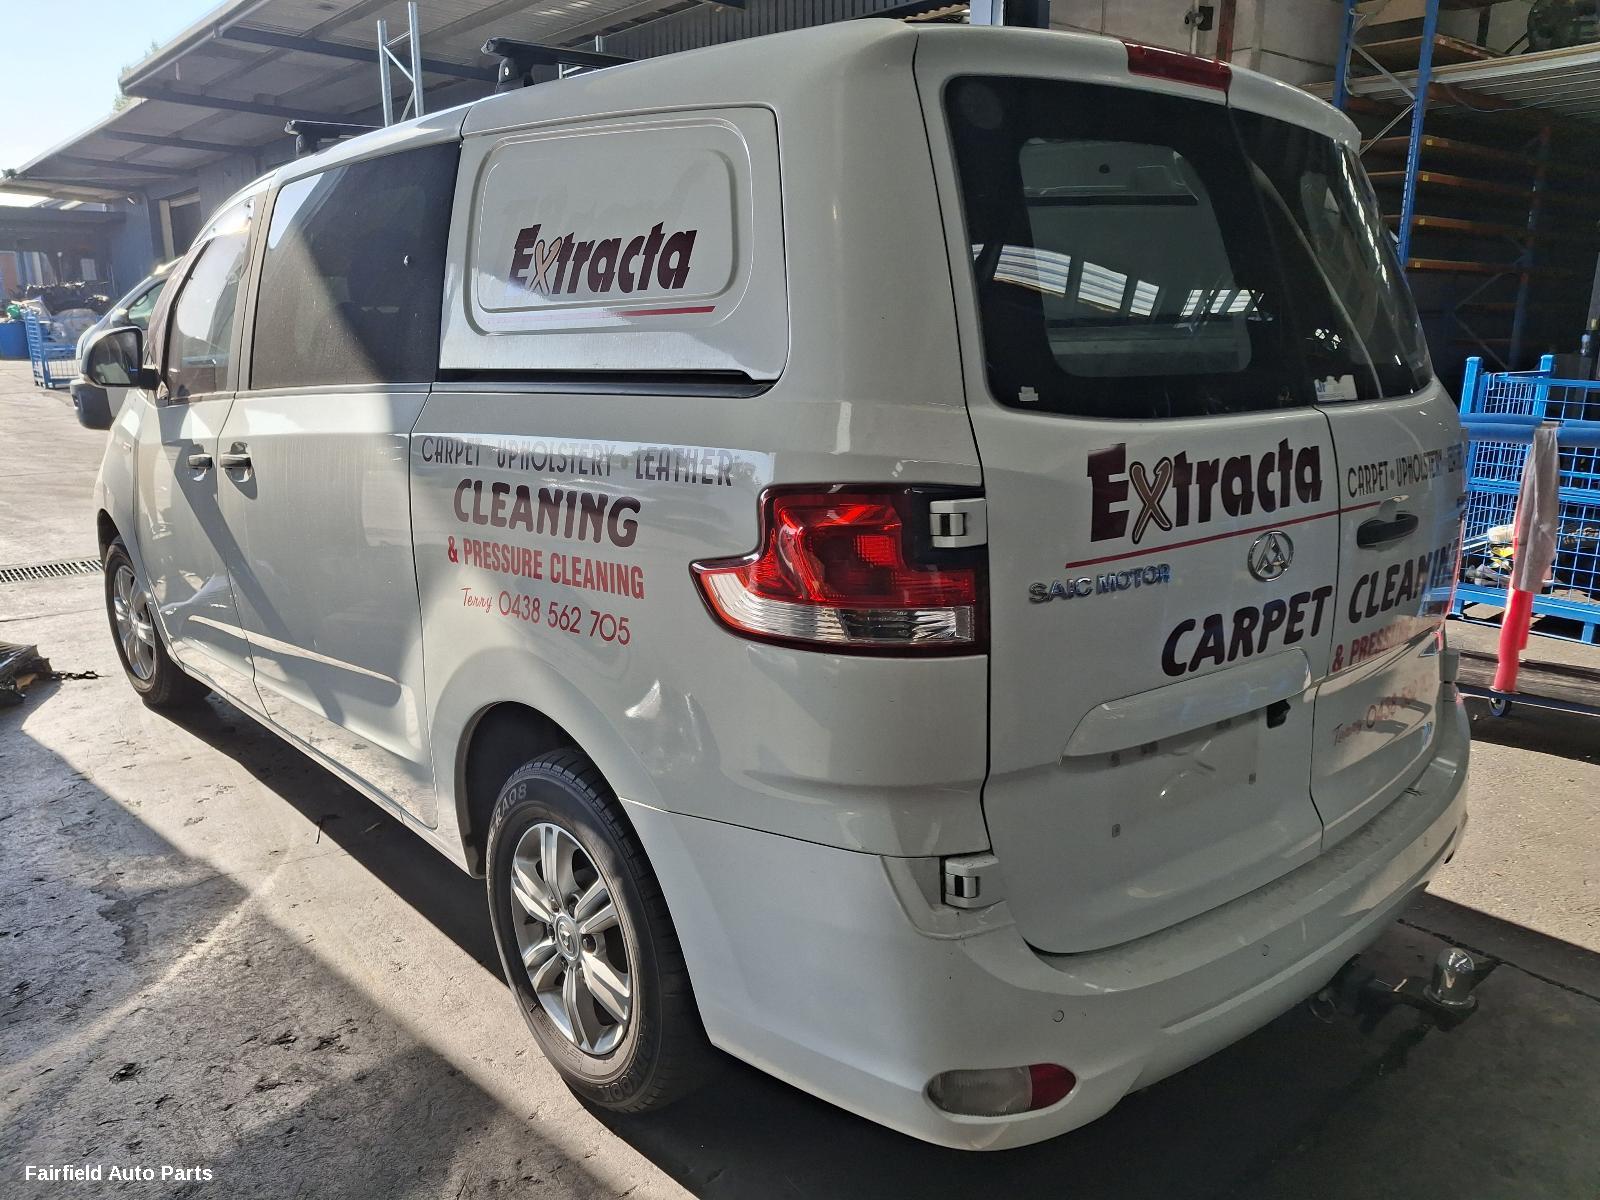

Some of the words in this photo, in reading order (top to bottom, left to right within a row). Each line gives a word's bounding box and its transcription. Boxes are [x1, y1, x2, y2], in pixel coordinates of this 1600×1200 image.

[508, 221, 697, 296] Extracta
[422, 437, 481, 466] CARPET
[496, 440, 616, 477] UPHOLSTERY
[635, 446, 734, 487] LEATHER
[1087, 437, 1322, 545] Extracta
[1348, 460, 1388, 498] CARPET
[453, 478, 641, 547] CLEANING
[448, 536, 459, 563] &
[463, 538, 543, 580] PRESSURE
[550, 552, 645, 599] CLEANING
[1029, 576, 1092, 604] SAIC
[1096, 563, 1172, 595] MOTOR
[461, 587, 493, 613] Terry
[498, 591, 540, 624] 0438
[547, 601, 581, 634] 562
[590, 610, 631, 646] 705
[1161, 585, 1333, 676] CARPET
